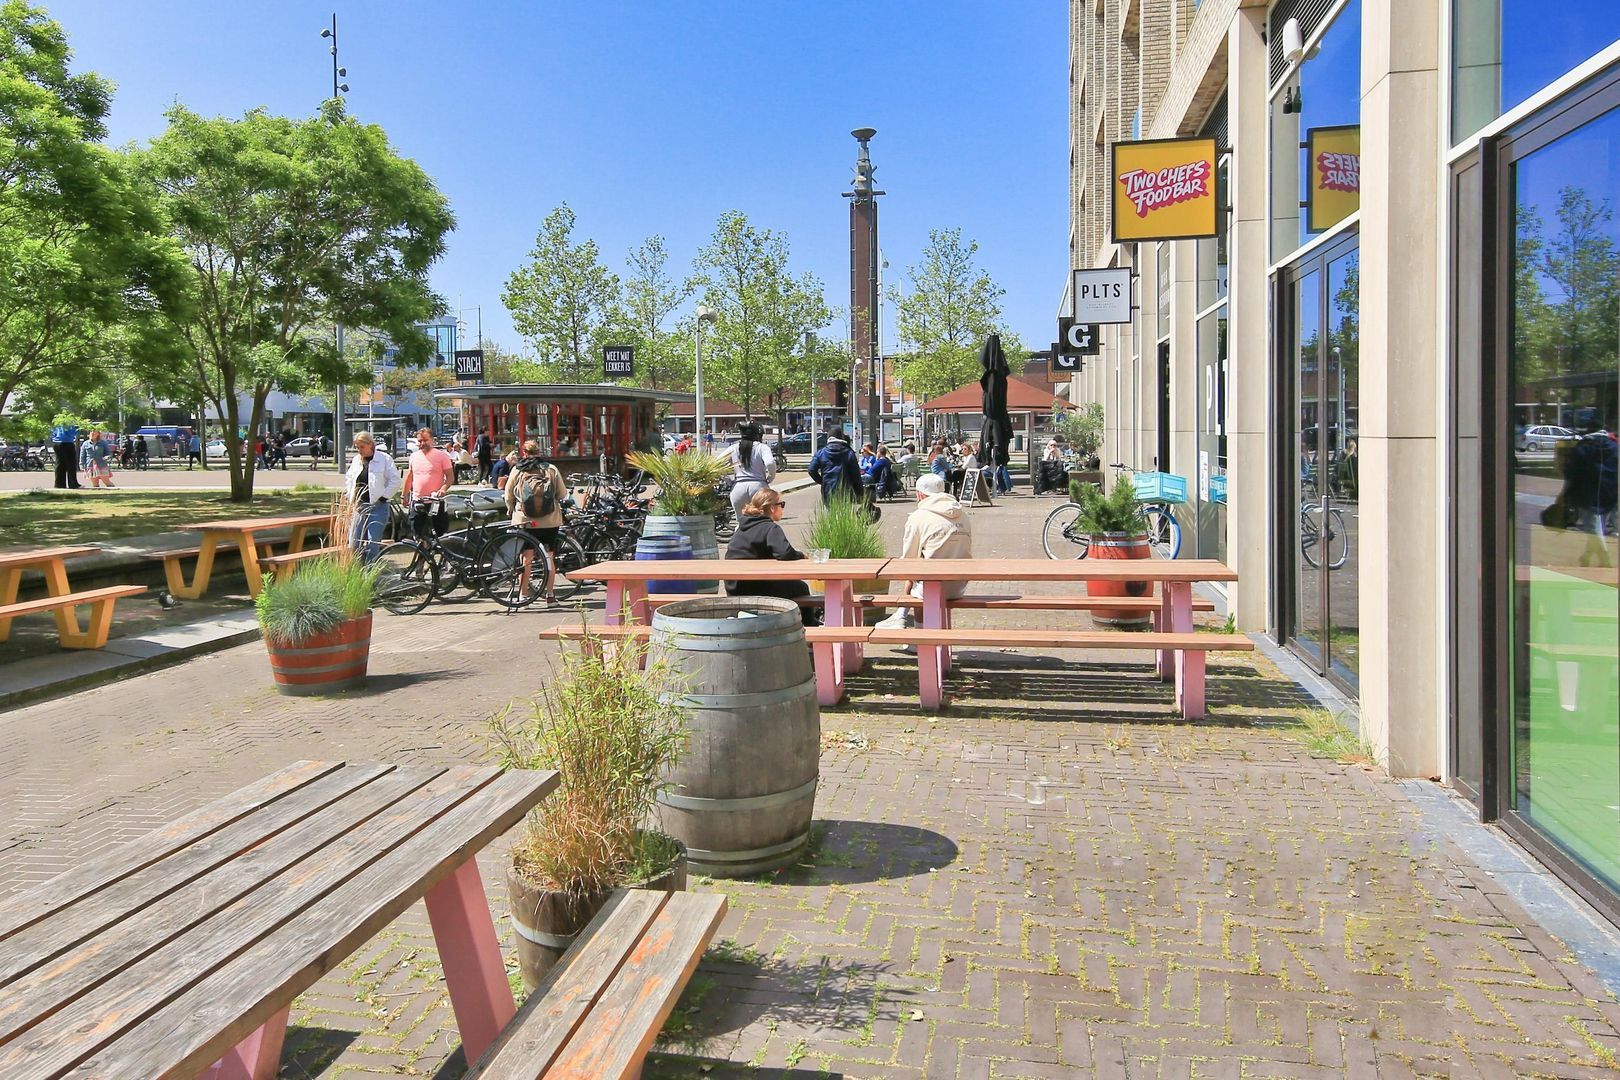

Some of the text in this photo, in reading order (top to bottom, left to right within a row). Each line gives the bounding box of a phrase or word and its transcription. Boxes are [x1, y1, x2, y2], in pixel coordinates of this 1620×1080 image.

[1119, 160, 1206, 195] TWO CHEFS
[1082, 283, 1121, 299] PLTS
[1067, 324, 1091, 348] G
[457, 356, 481, 372] STACH
[606, 351, 630, 361] WEET WAT
[605, 362, 631, 372] LEKKER IS
